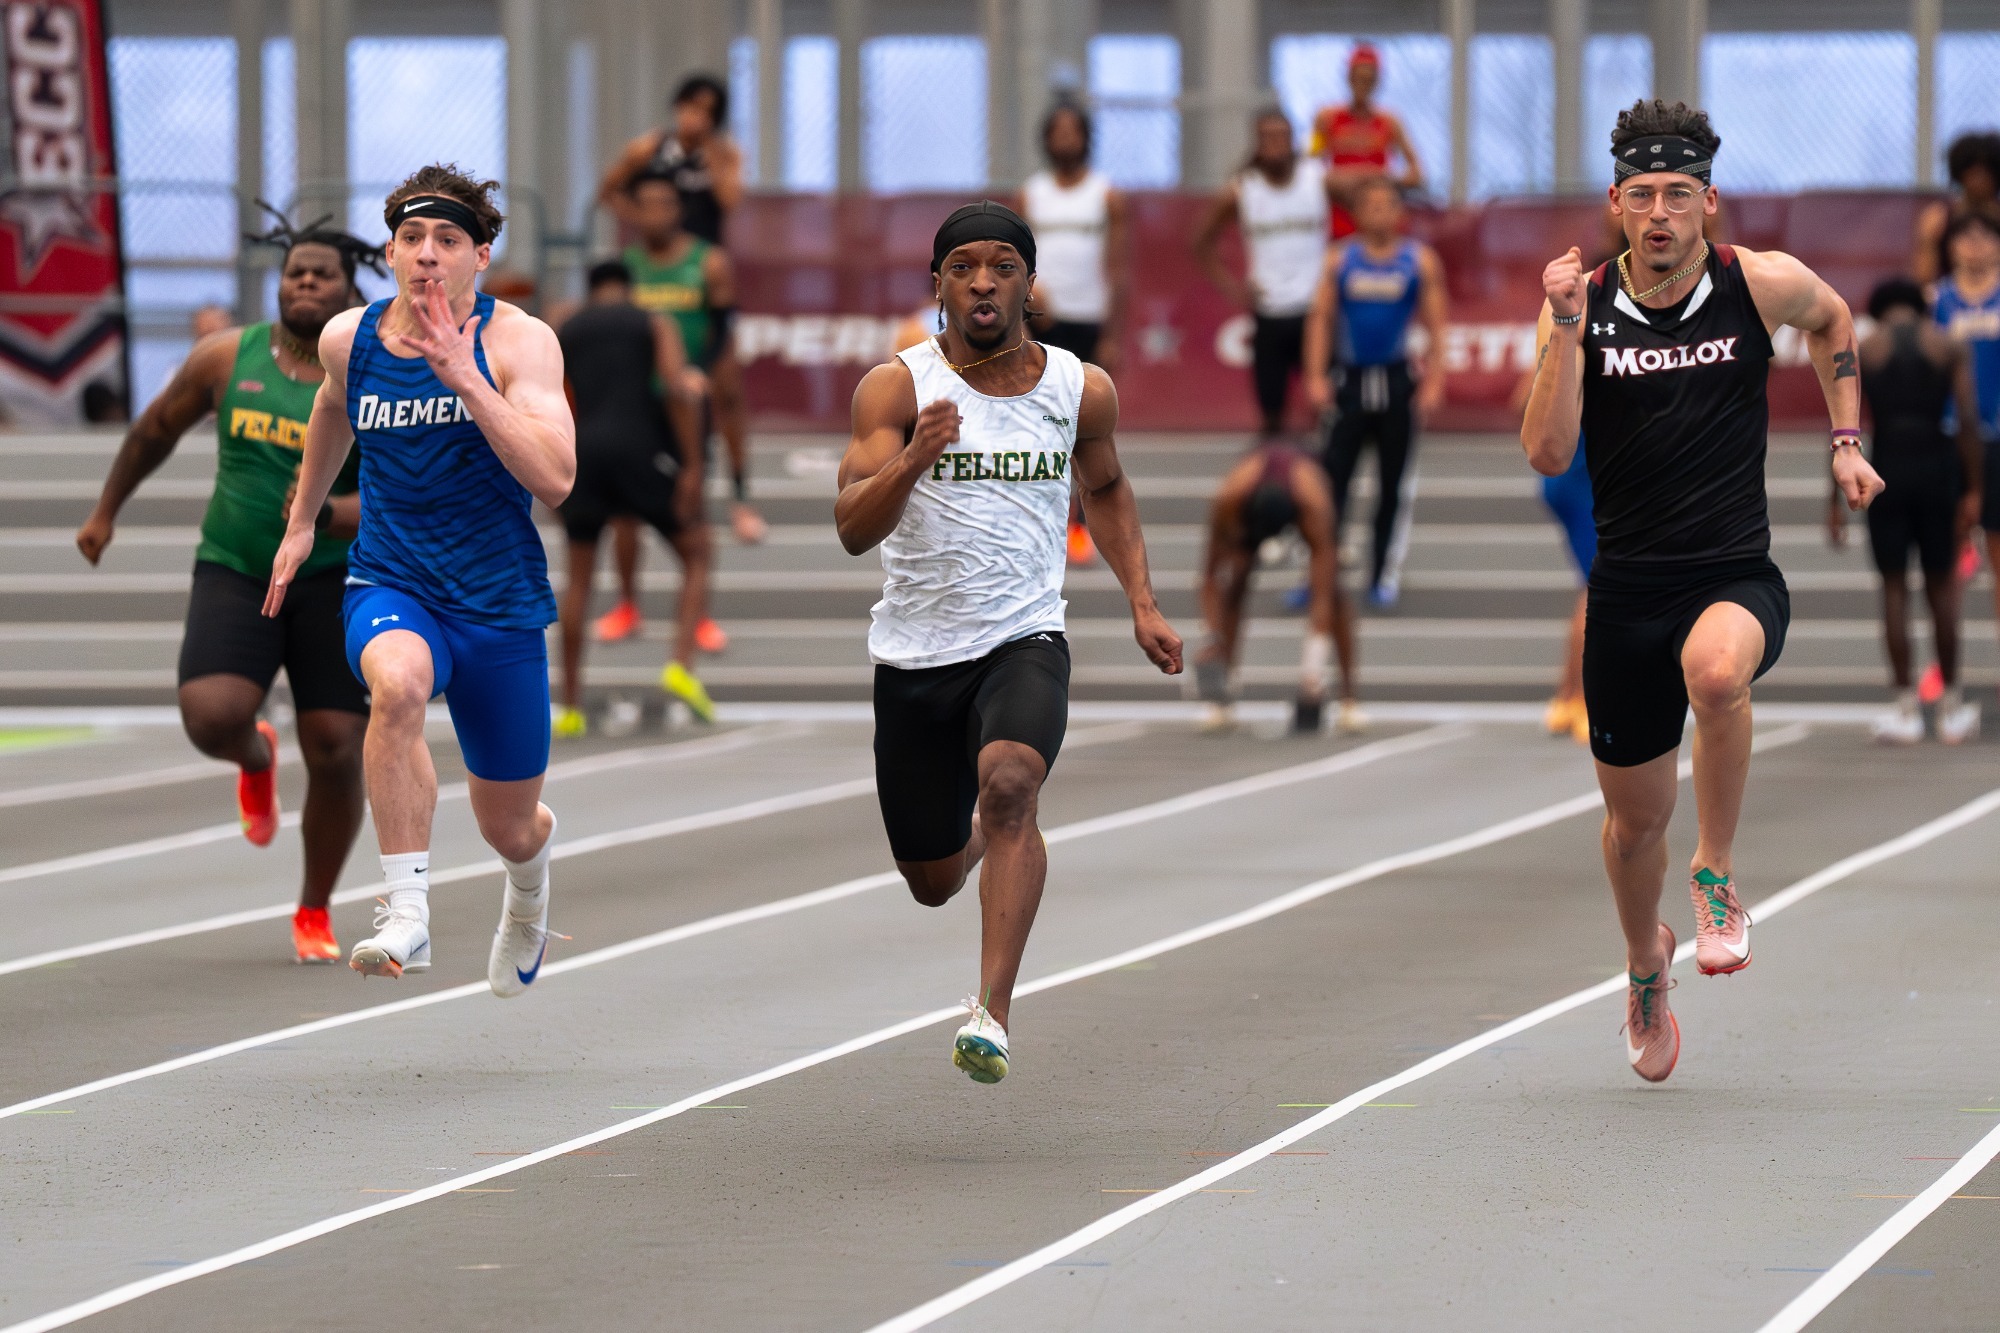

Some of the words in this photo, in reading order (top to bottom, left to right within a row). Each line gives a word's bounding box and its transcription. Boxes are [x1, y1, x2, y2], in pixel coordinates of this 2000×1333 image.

[10, 3, 86, 188] ECC
[1600, 336, 1740, 380] MOLLOY
[356, 394, 474, 431] DAEMEN
[931, 450, 1068, 482] FELICIAN
